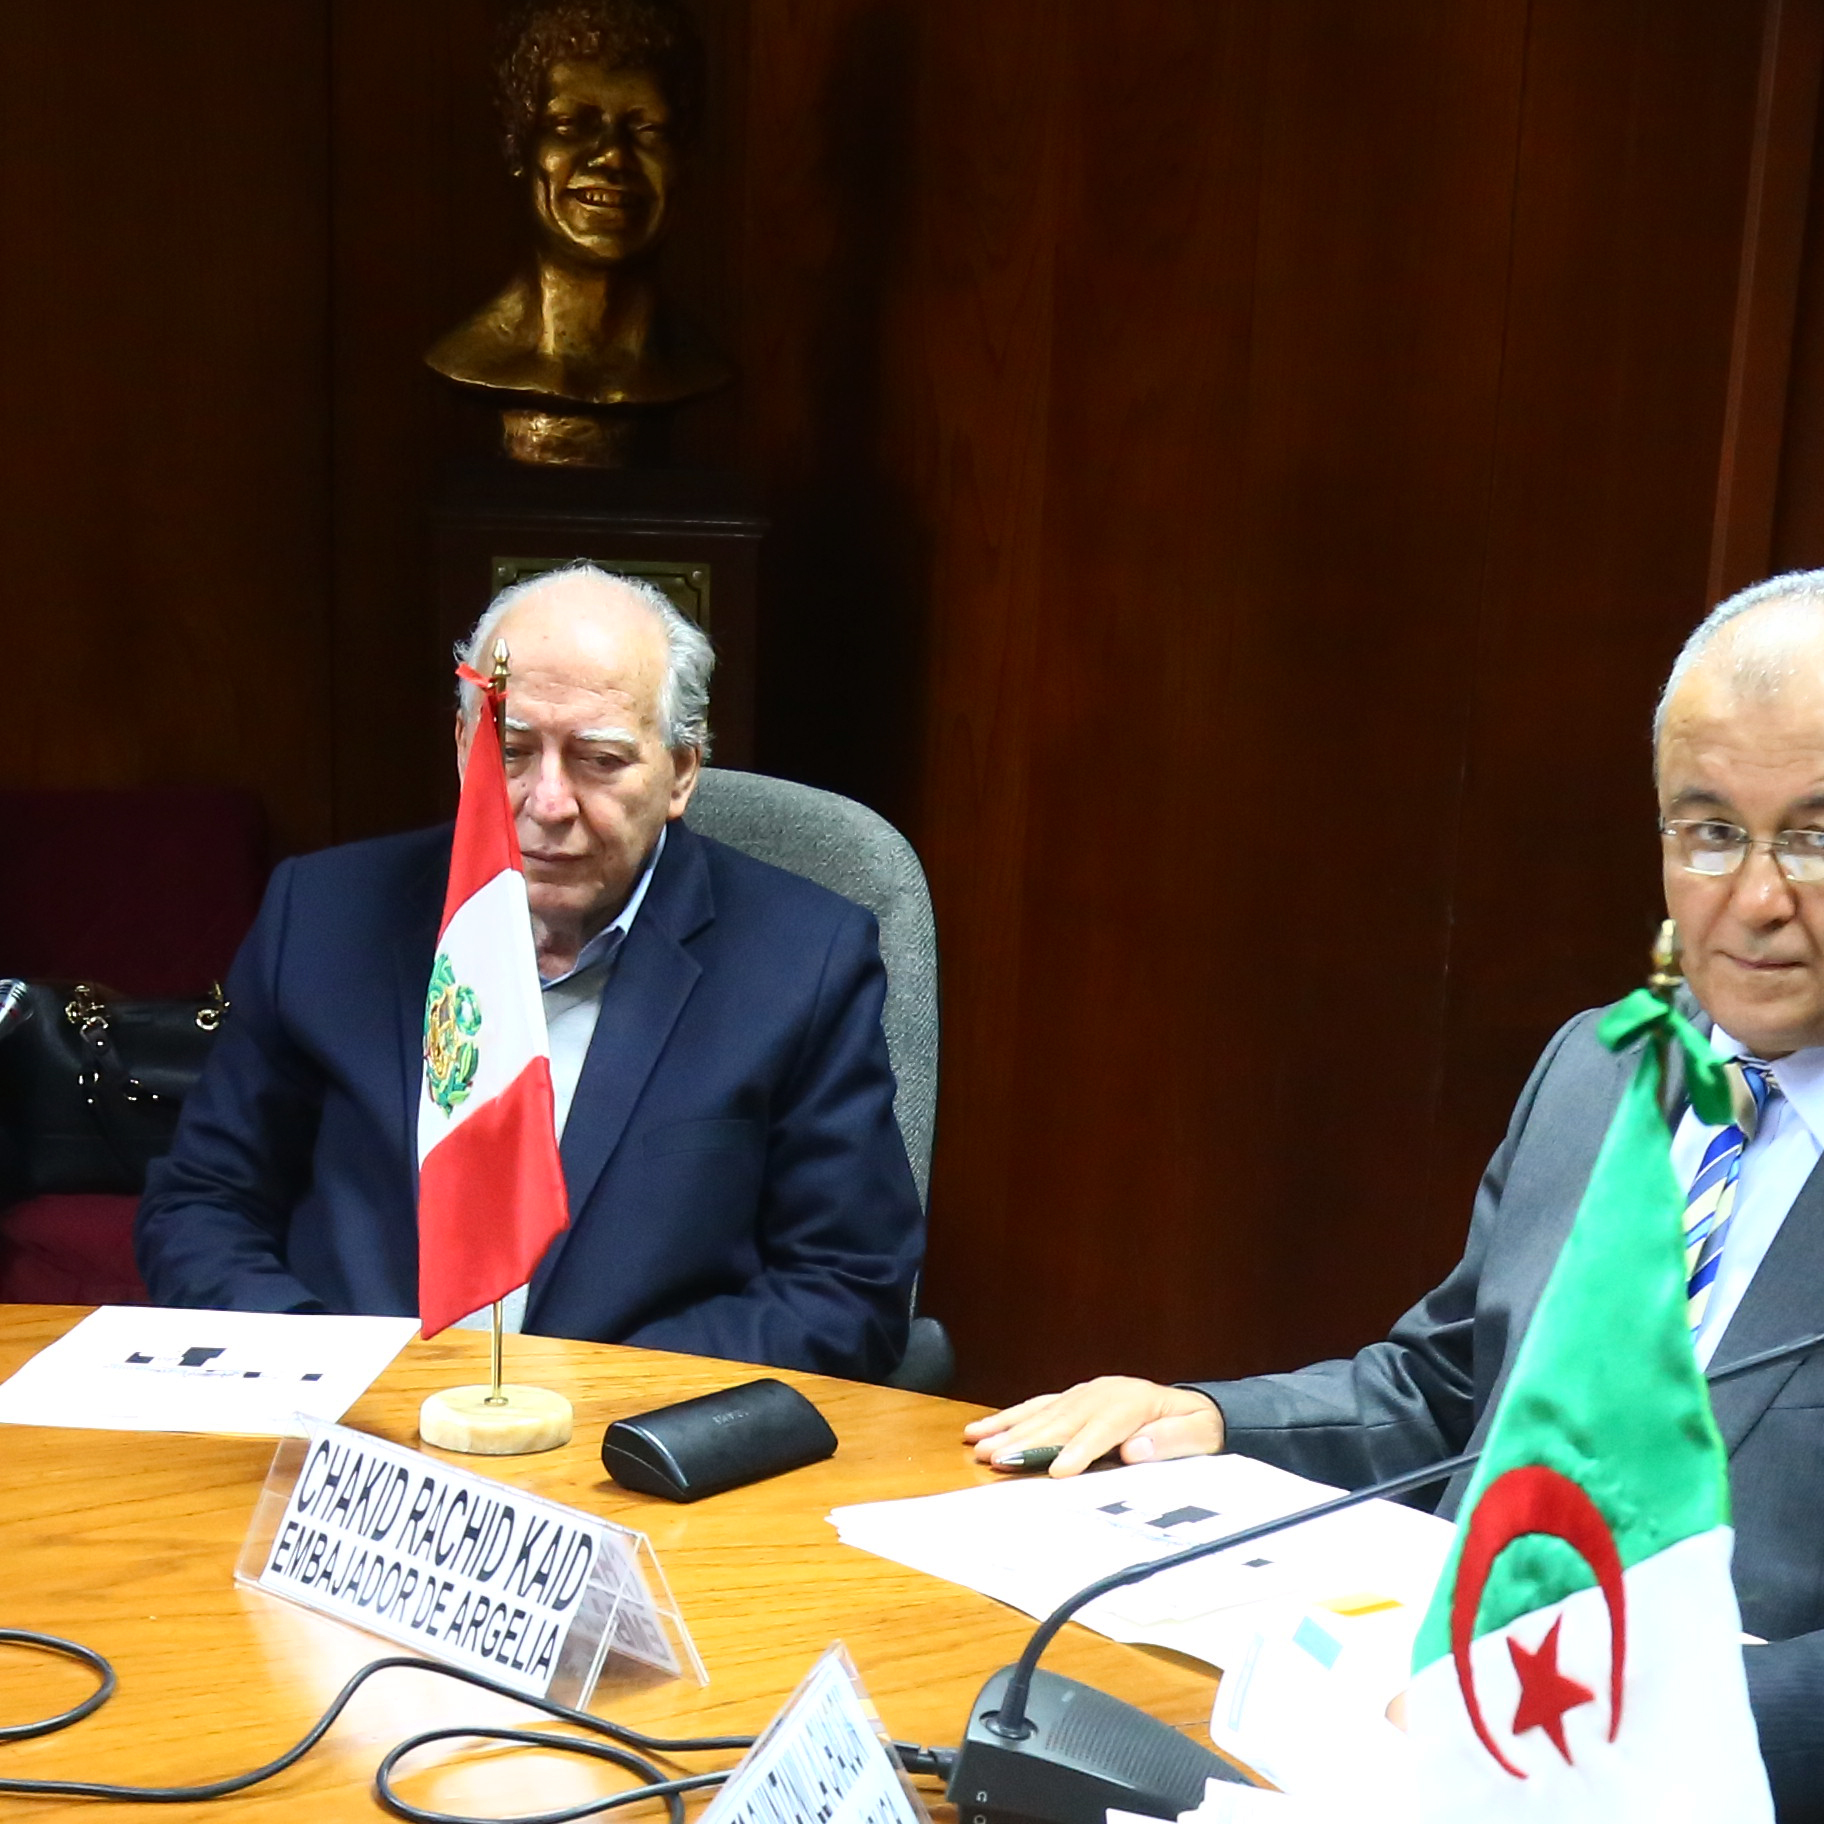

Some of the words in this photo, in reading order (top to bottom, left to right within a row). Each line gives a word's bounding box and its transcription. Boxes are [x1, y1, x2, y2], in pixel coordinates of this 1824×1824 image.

[271, 1521, 419, 1625] EMBAJADOR
[412, 1575, 454, 1637] DE
[444, 1591, 561, 1681] ARGELIA
[296, 1440, 408, 1542] CHAKID
[409, 1477, 515, 1582] RACHID
[505, 1515, 592, 1611] KAID
